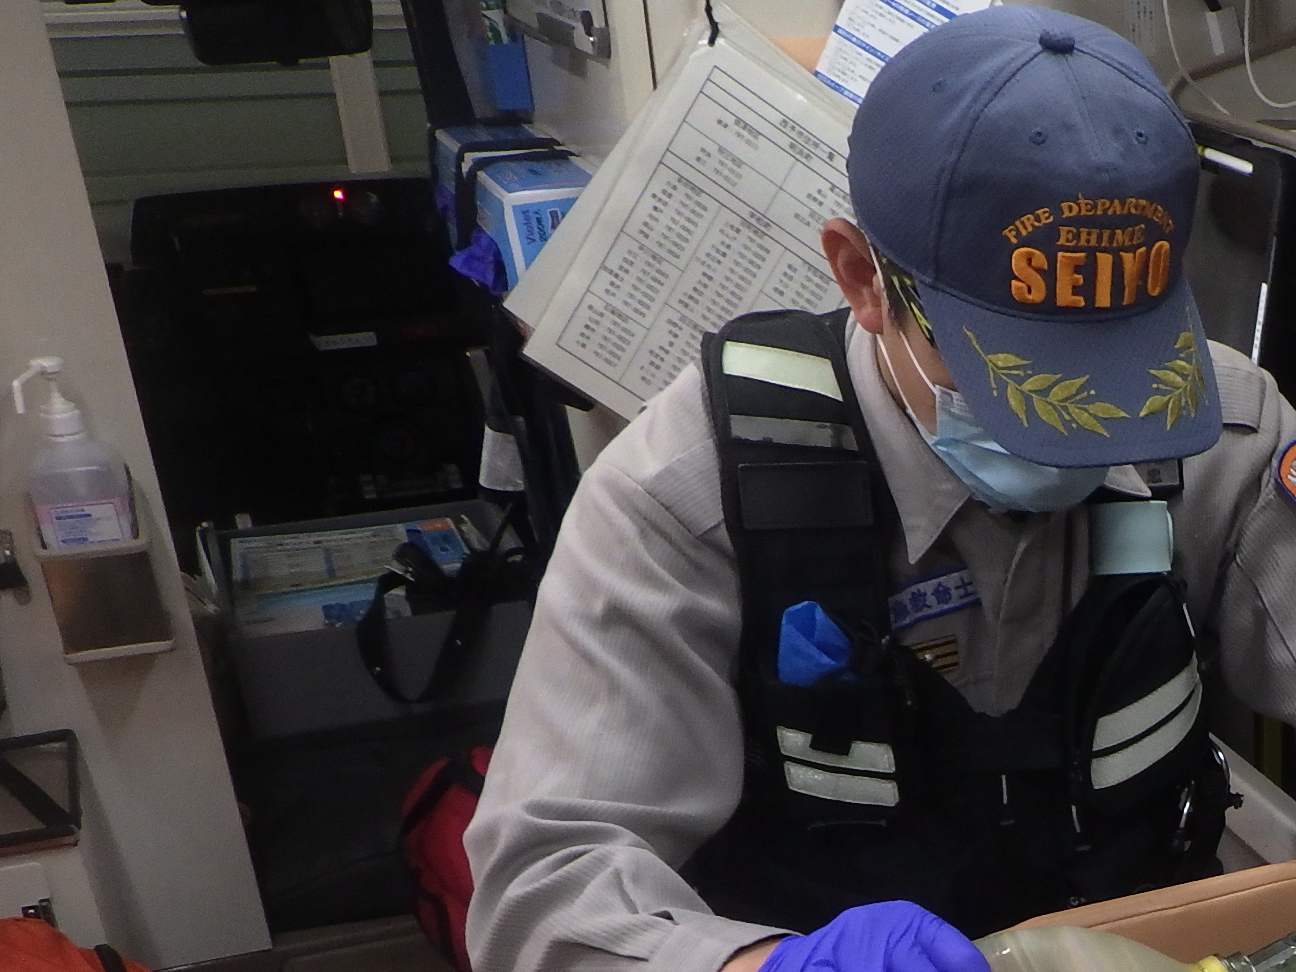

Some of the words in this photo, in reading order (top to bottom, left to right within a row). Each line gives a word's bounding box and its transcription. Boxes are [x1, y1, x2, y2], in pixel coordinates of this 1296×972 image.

[521, 209, 537, 245] Violet
[1002, 207, 1054, 245] FIRE
[1056, 224, 1145, 247] EHIME
[1010, 240, 1170, 308] SEIYO
